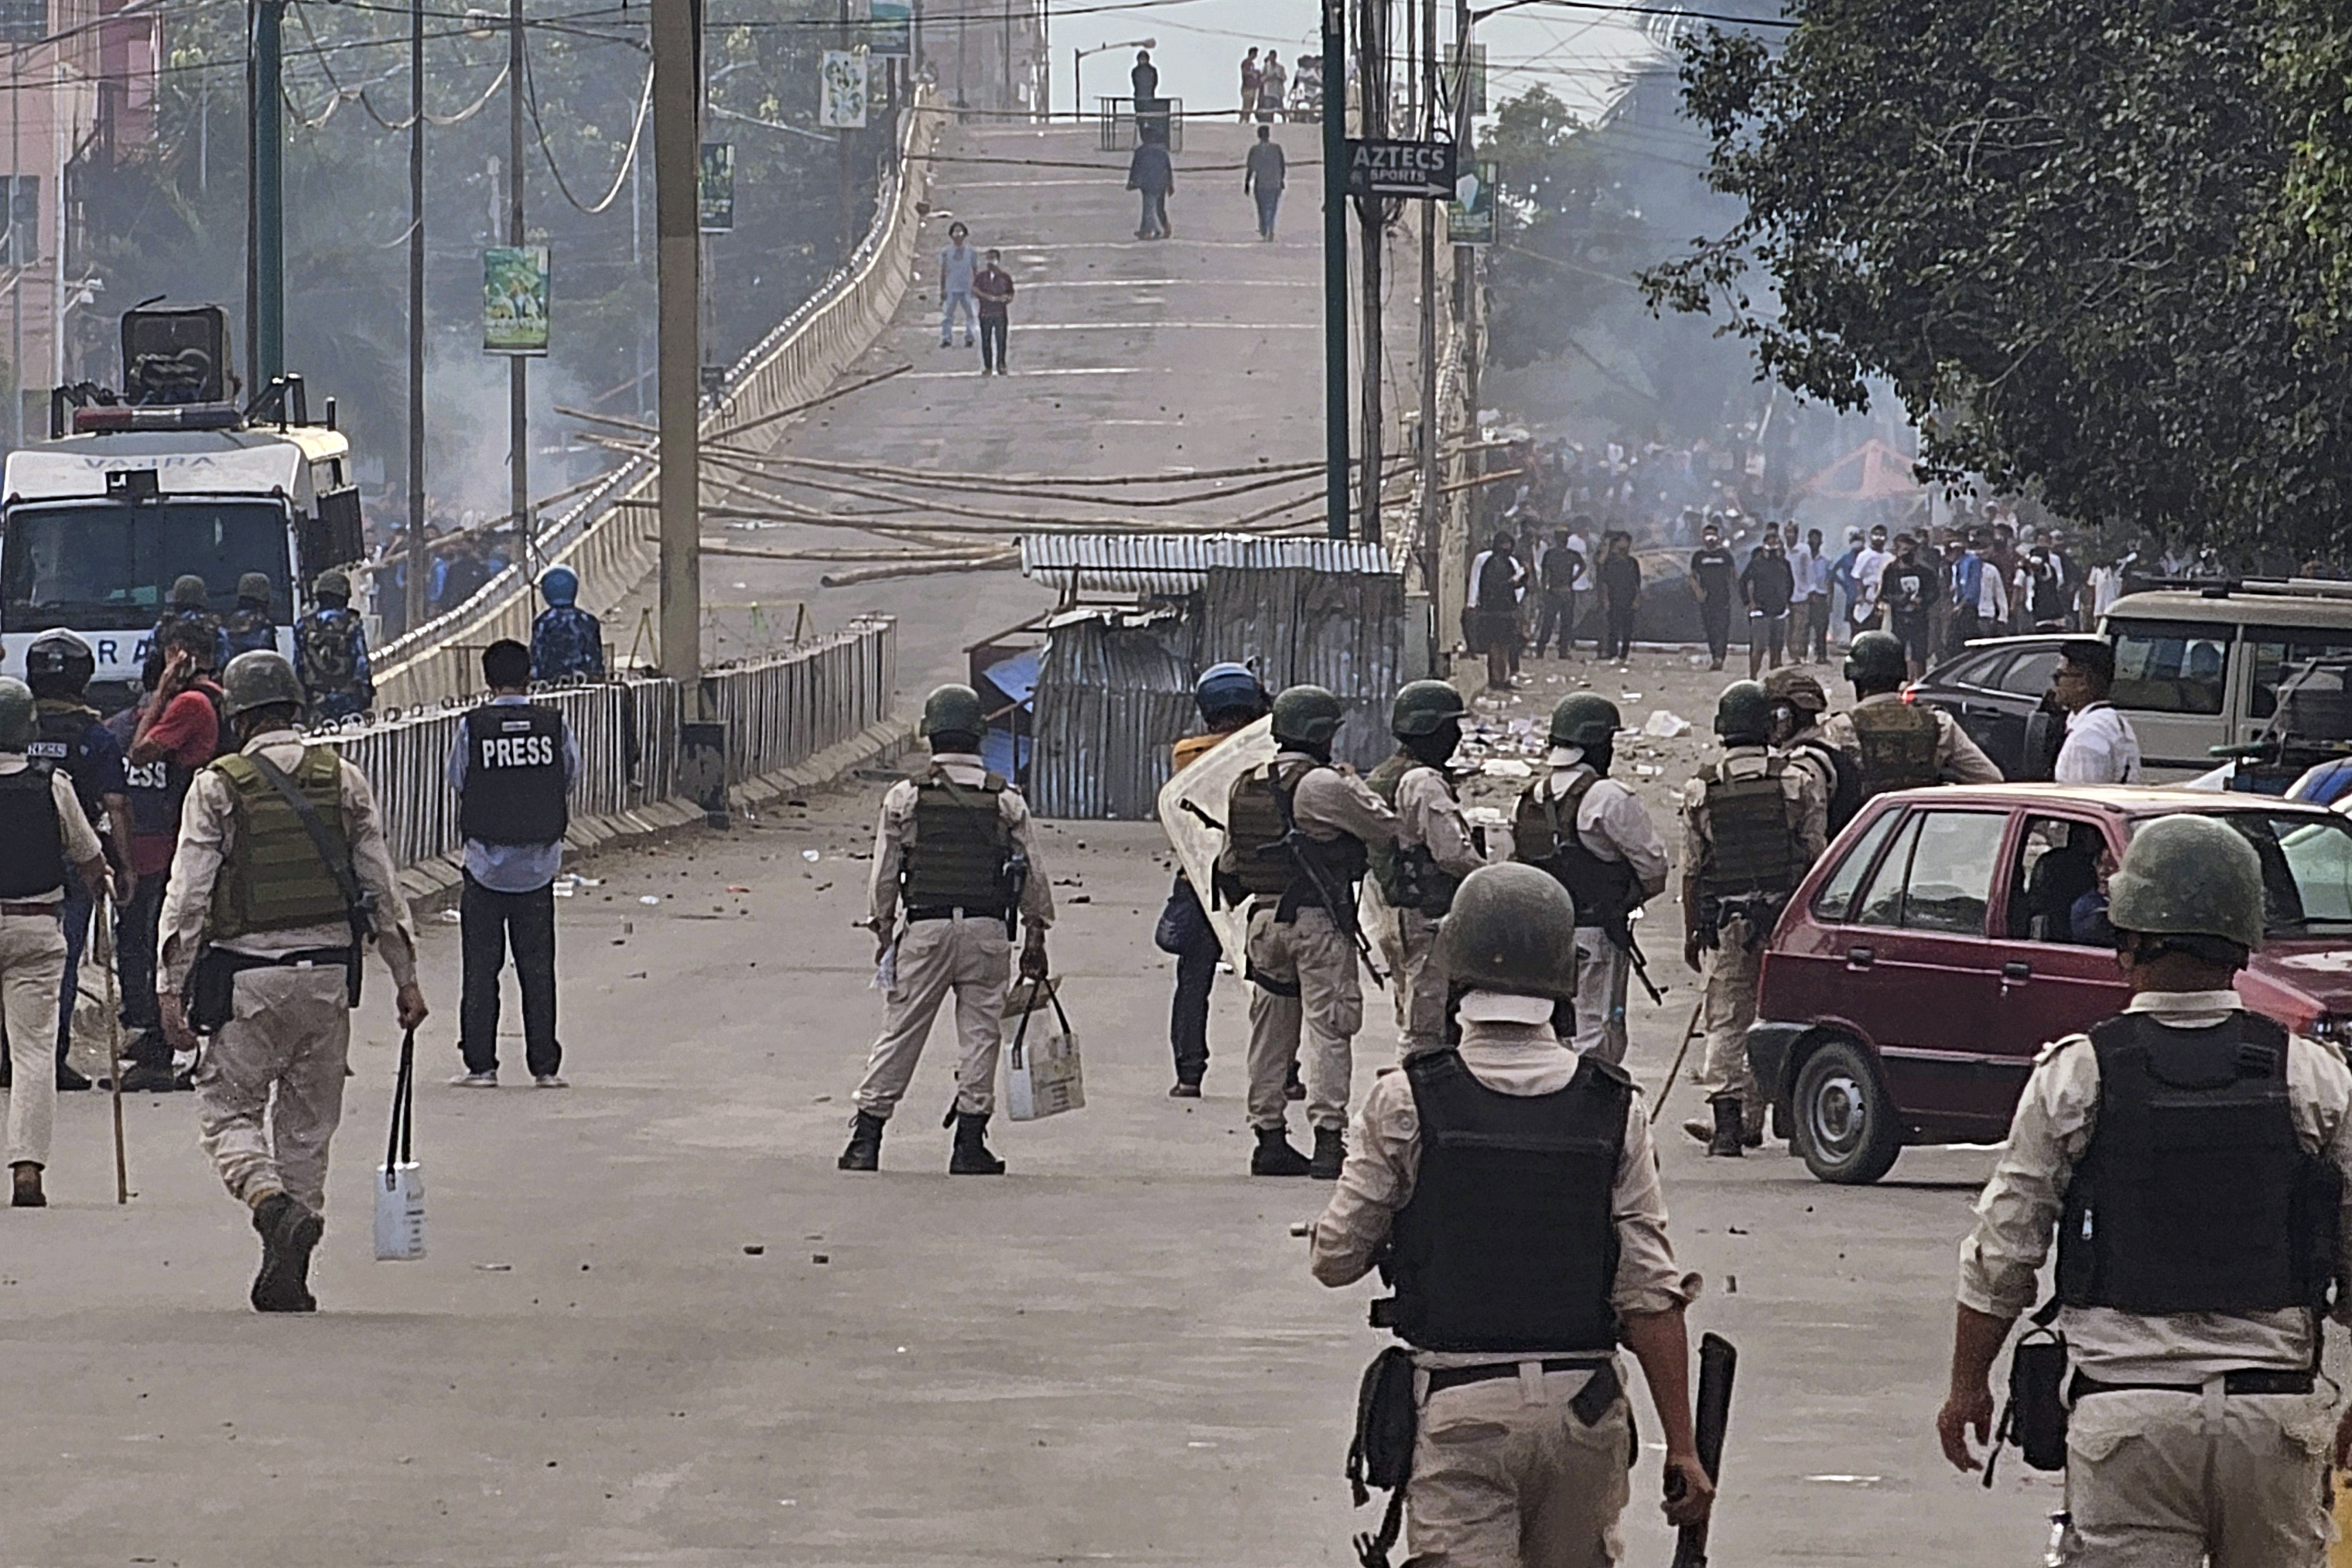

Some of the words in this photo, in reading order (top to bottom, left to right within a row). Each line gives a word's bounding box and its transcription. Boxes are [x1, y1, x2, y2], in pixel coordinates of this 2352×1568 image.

[1352, 145, 1445, 171] AZTECS
[1369, 169, 1427, 183] SPORTS
[482, 736, 553, 770] PRESS
